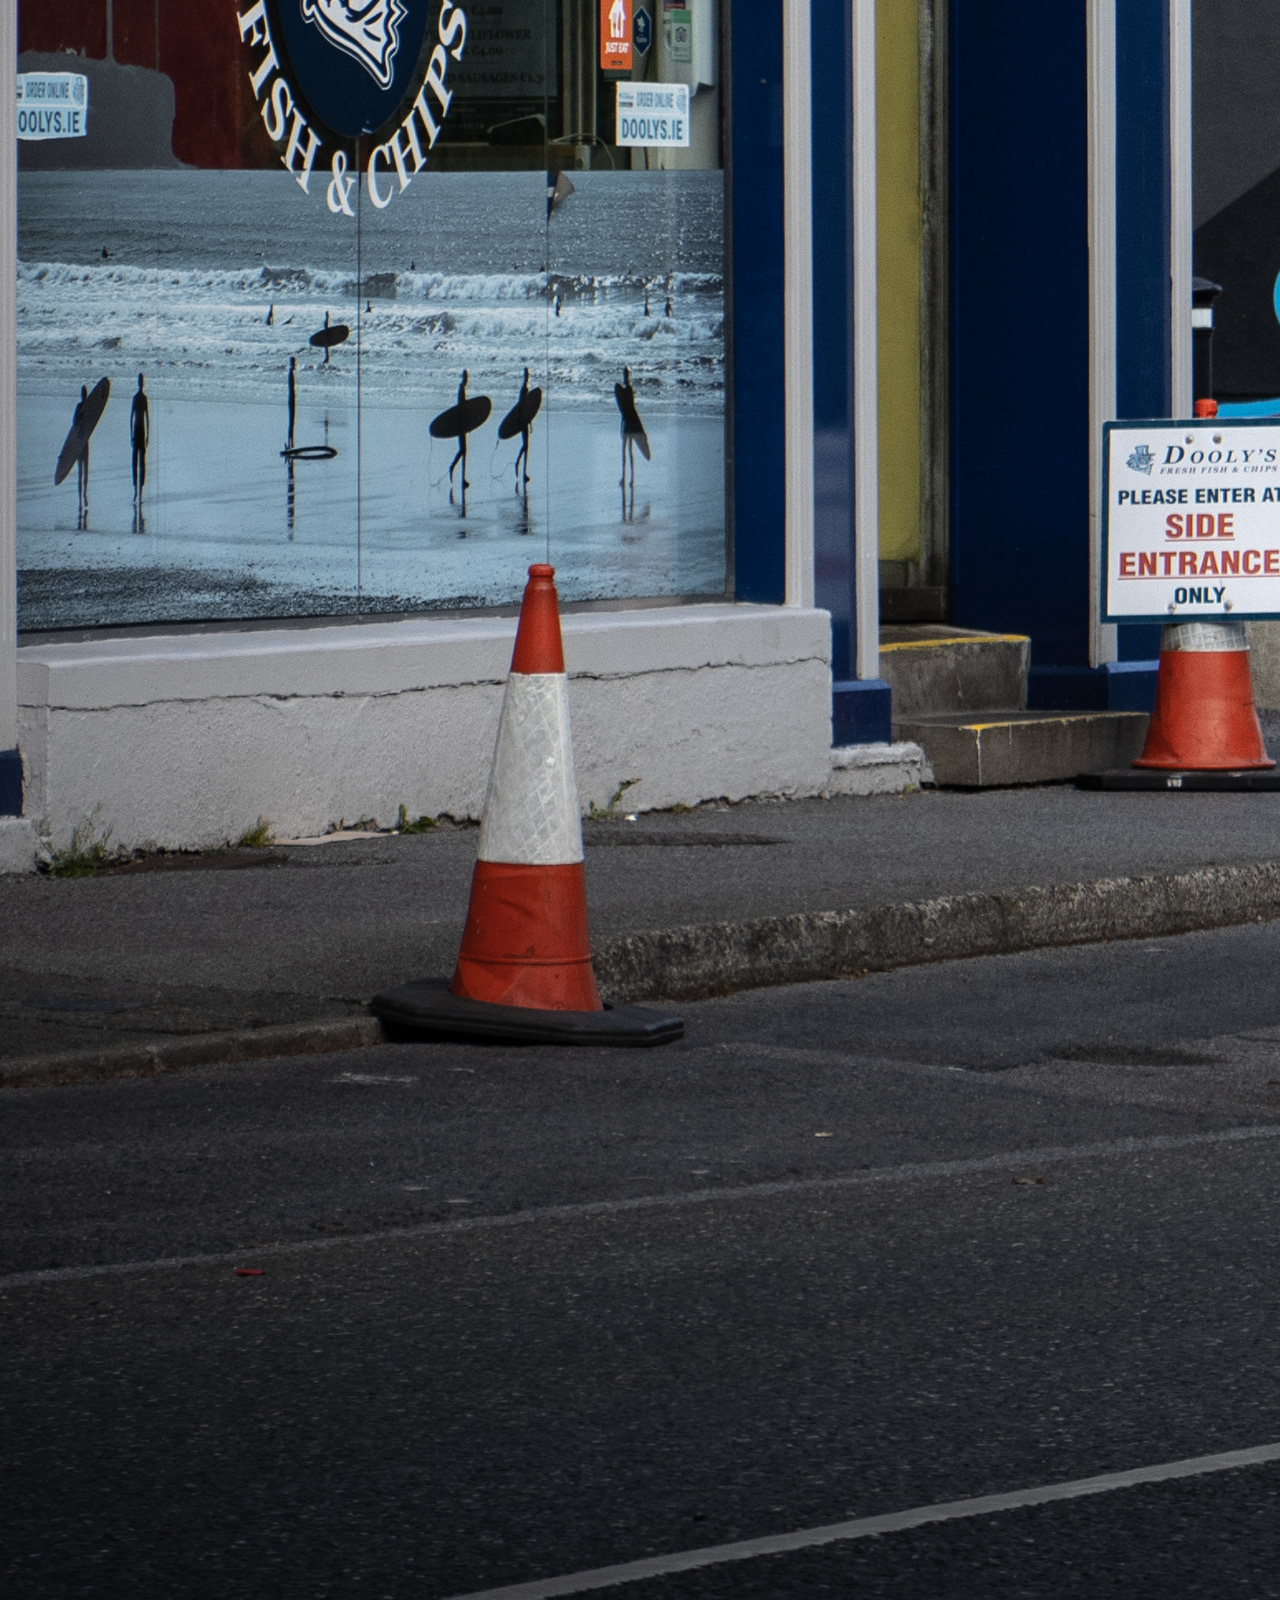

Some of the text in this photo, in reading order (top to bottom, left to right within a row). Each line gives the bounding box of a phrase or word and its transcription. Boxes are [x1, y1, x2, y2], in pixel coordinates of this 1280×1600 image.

[605, 42, 629, 54] JUST EAT
[18, 110, 80, 133] OOLYS.IE
[621, 117, 683, 140] DOOLYS.IE
[326, 150, 356, 217] &
[1162, 445, 1278, 465] DOOLY'S
[1160, 466, 1196, 475] FRESH
[1200, 466, 1227, 474] FISH
[1243, 465, 1278, 473] CHIPS
[1118, 488, 1188, 505] PLEASE
[1195, 487, 1255, 504] ENTER
[1165, 513, 1234, 539] SIDE
[1119, 550, 1280, 577] ENTRANCE
[1174, 586, 1226, 605] ONLY
